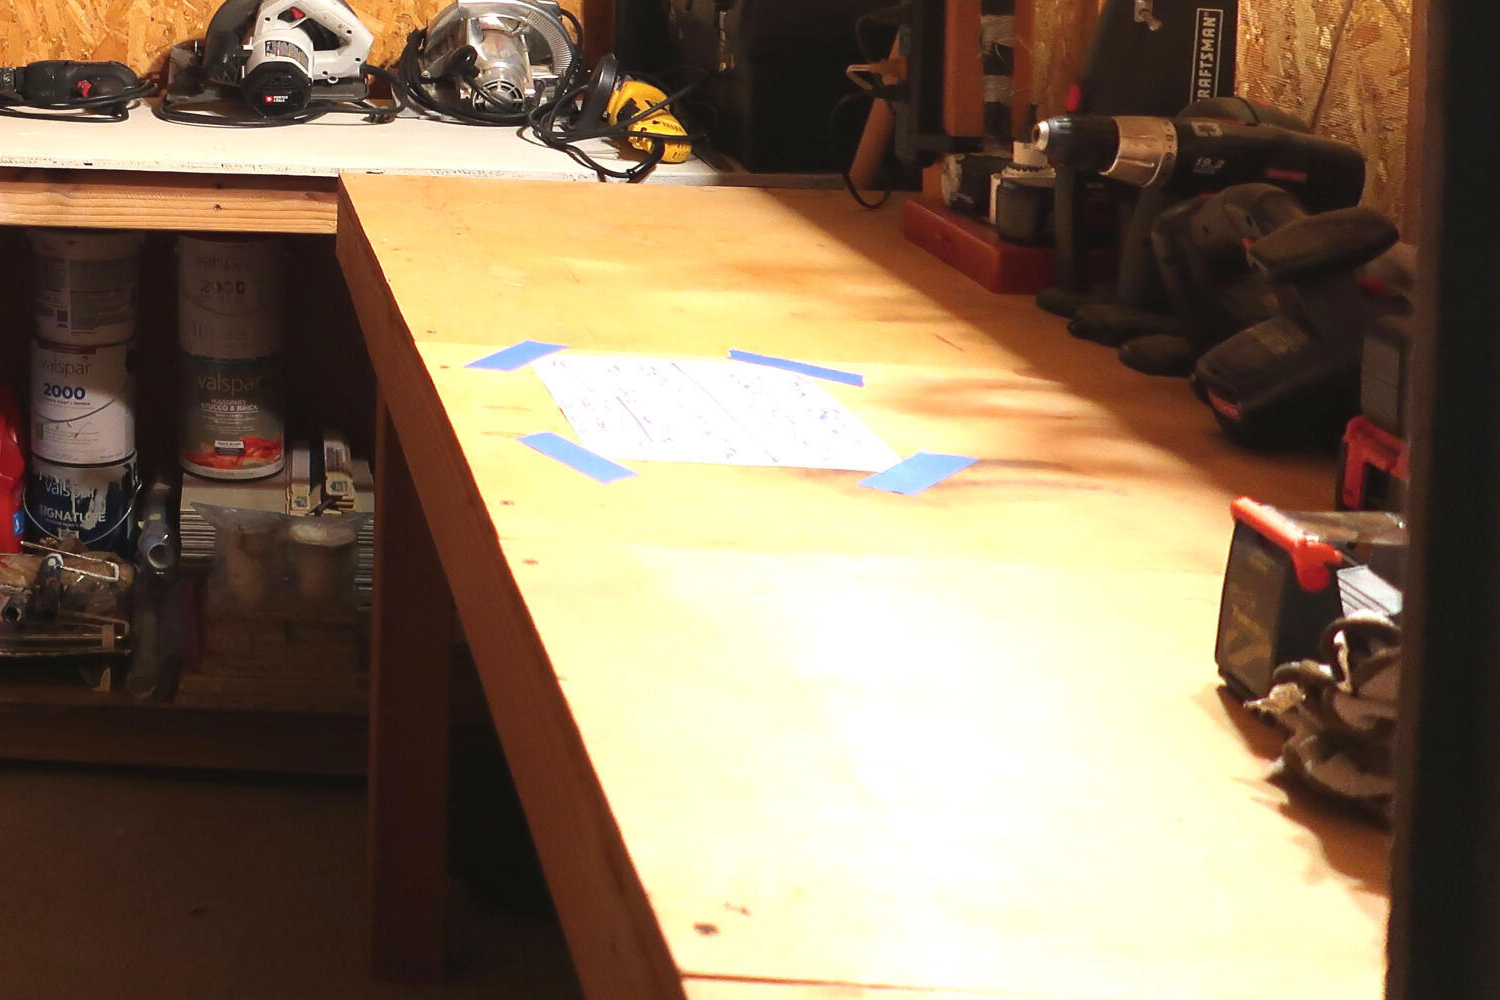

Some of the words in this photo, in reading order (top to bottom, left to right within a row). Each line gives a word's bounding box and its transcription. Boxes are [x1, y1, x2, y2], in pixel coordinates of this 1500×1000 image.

[1196, 15, 1217, 103] RAFTSMAN
[43, 382, 86, 401] 2000
[196, 373, 263, 396] valspar
